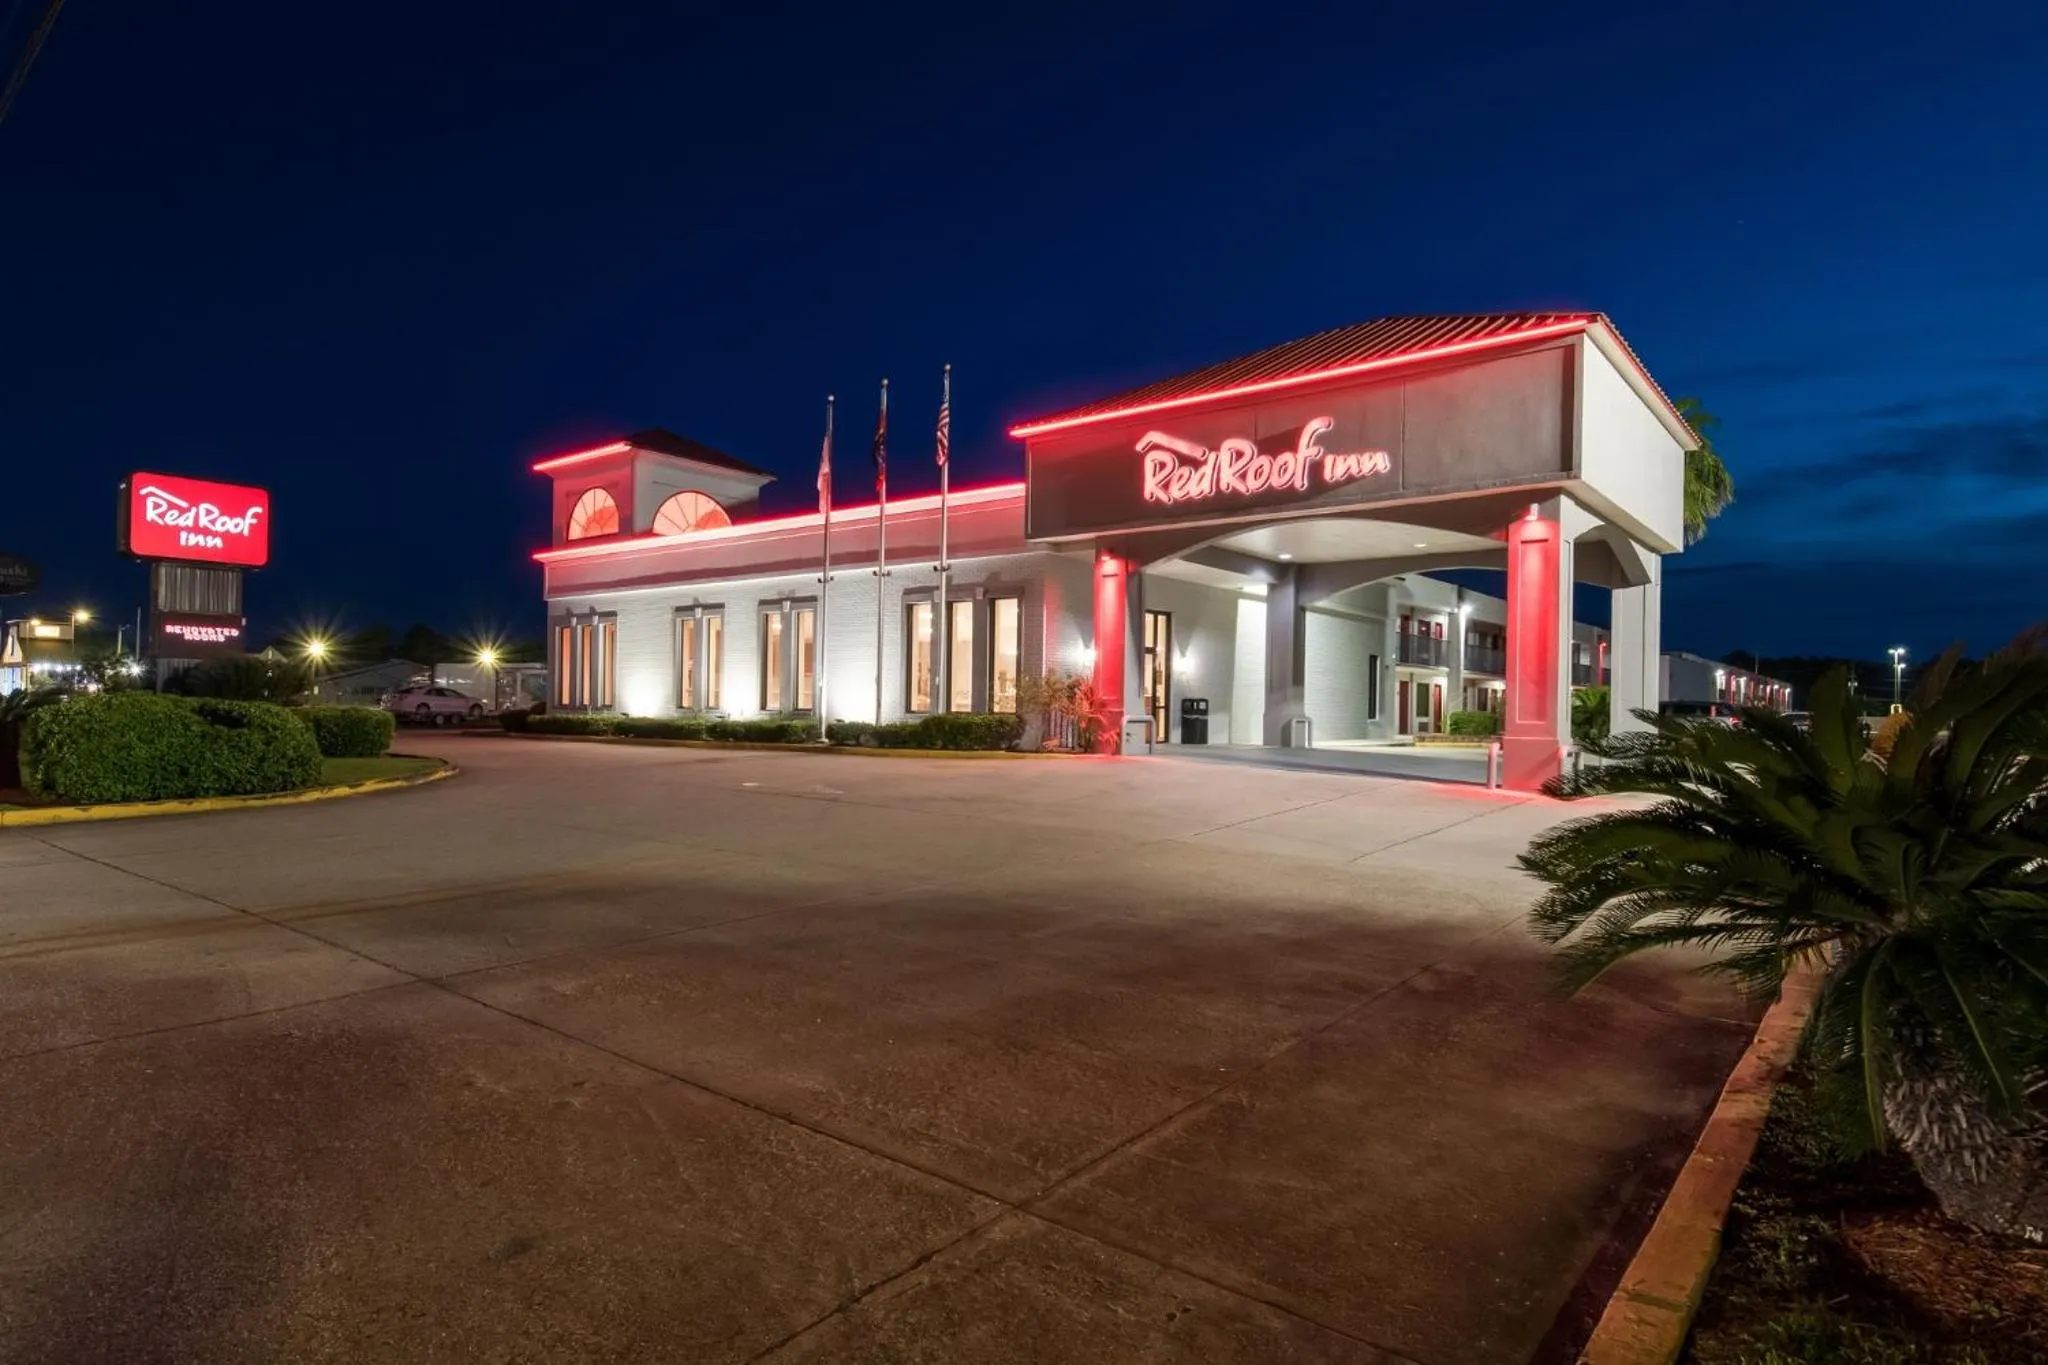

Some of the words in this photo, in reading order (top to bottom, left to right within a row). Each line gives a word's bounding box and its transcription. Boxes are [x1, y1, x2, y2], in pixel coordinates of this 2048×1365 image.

[1144, 448, 1218, 503] Red
[1219, 417, 1334, 495] Roof
[146, 496, 196, 527] Red
[198, 503, 263, 536] Roof
